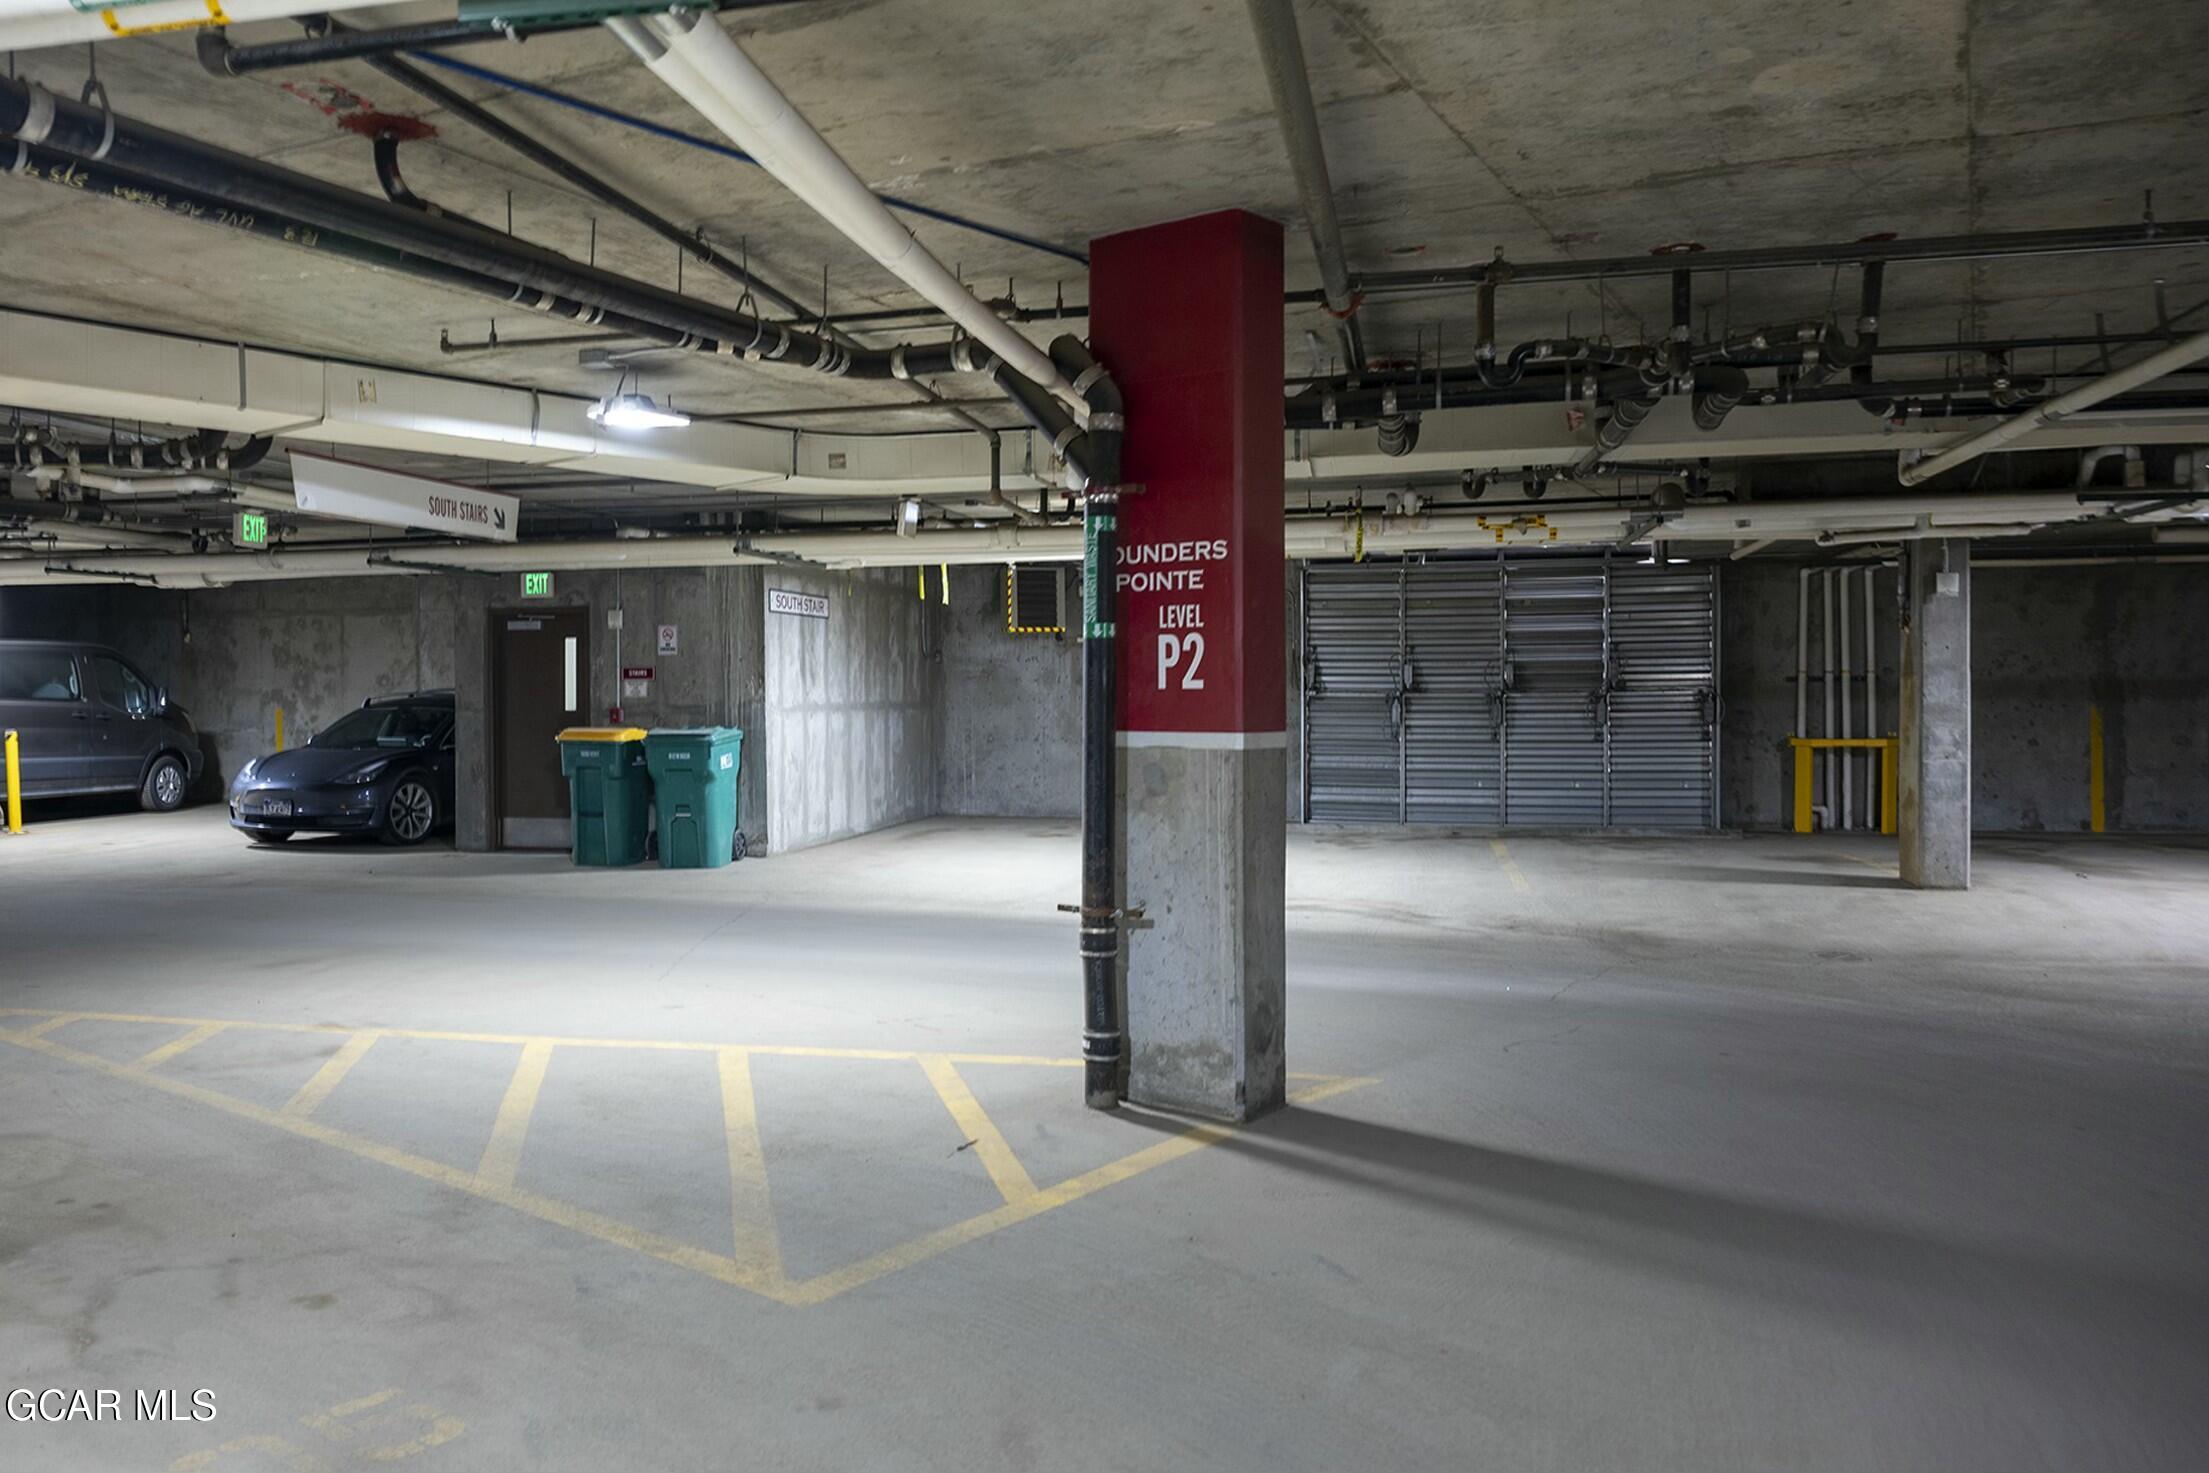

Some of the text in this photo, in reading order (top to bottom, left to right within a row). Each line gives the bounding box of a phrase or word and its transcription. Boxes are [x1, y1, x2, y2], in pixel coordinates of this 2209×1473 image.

[428, 495, 488, 523] SOUTH STAIRS
[242, 514, 265, 543] EXIT
[525, 573, 548, 595] EXIT
[1116, 569, 1204, 592] POINTE
[775, 594, 825, 614] SOUTH STAIR
[1159, 603, 1204, 629] LEVEL
[1158, 632, 1204, 690] P2
